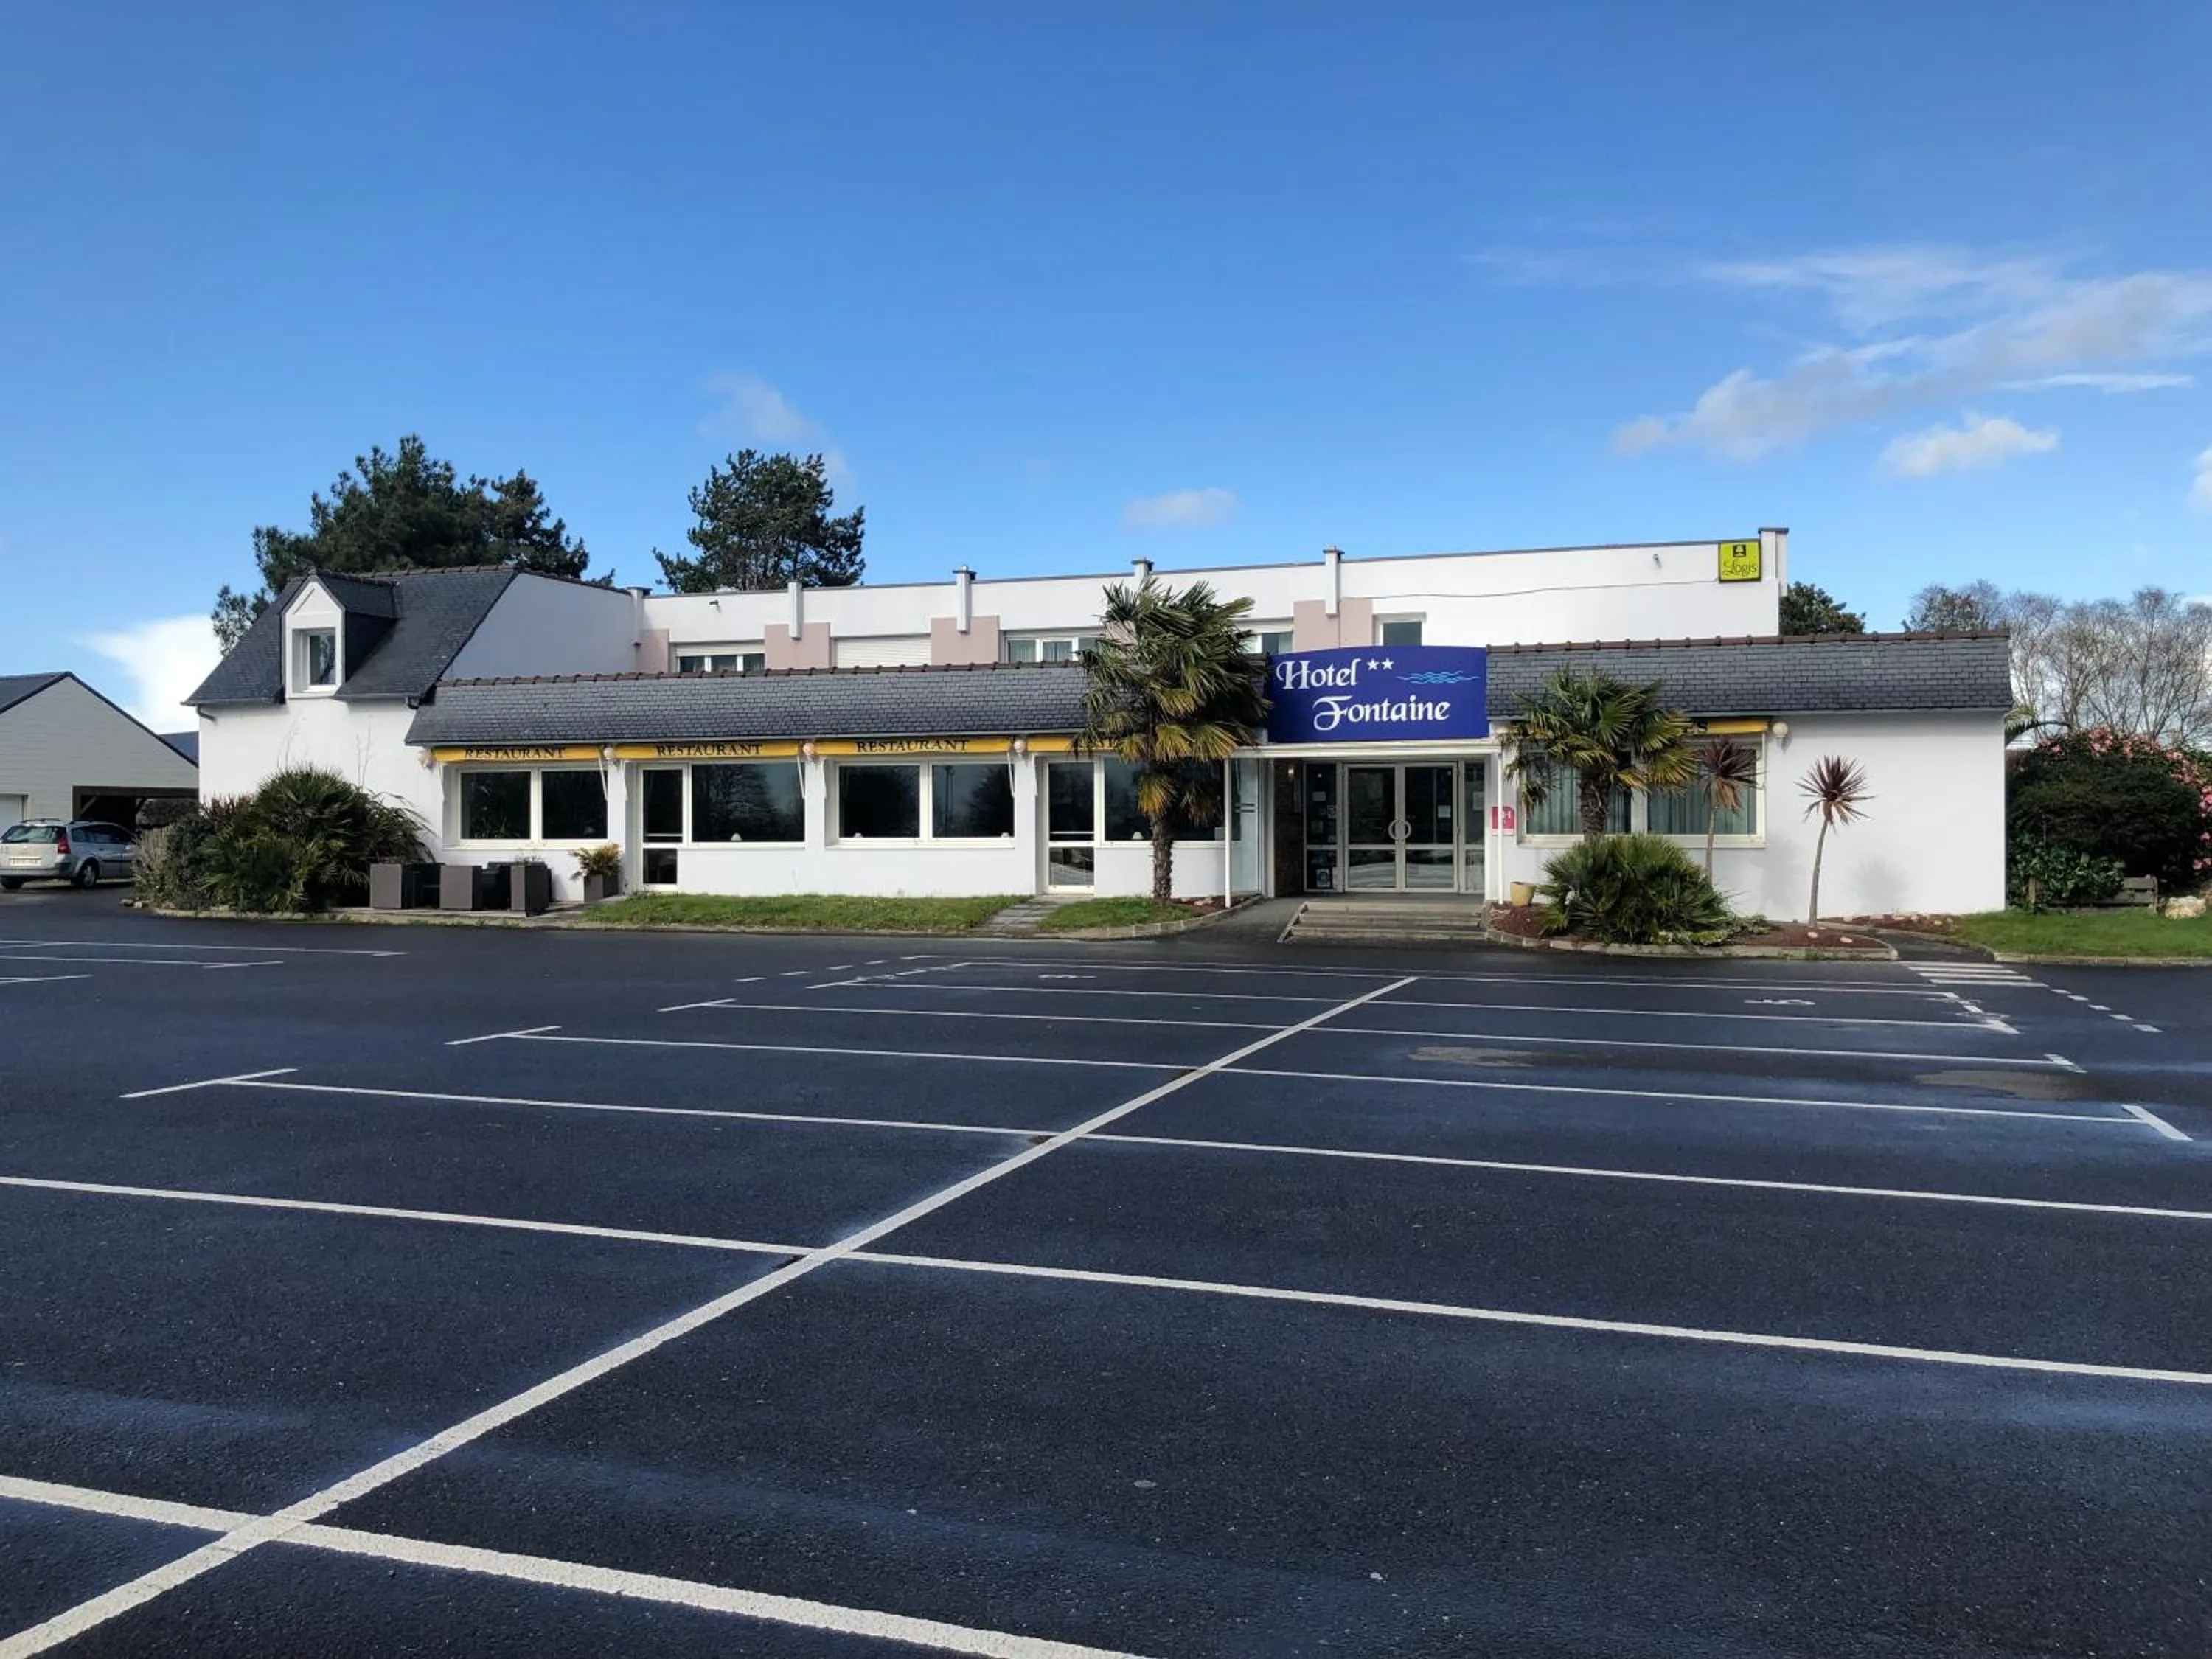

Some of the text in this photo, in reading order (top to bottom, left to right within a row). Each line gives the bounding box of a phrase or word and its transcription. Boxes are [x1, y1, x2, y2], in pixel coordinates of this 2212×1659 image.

[1276, 658, 1361, 689] Hotel
[1312, 695, 1451, 731] Fontaine
[655, 744, 763, 757] RESTAURANT
[855, 739, 970, 753] RESTAURANT
[463, 748, 566, 759] RESTAURANT
